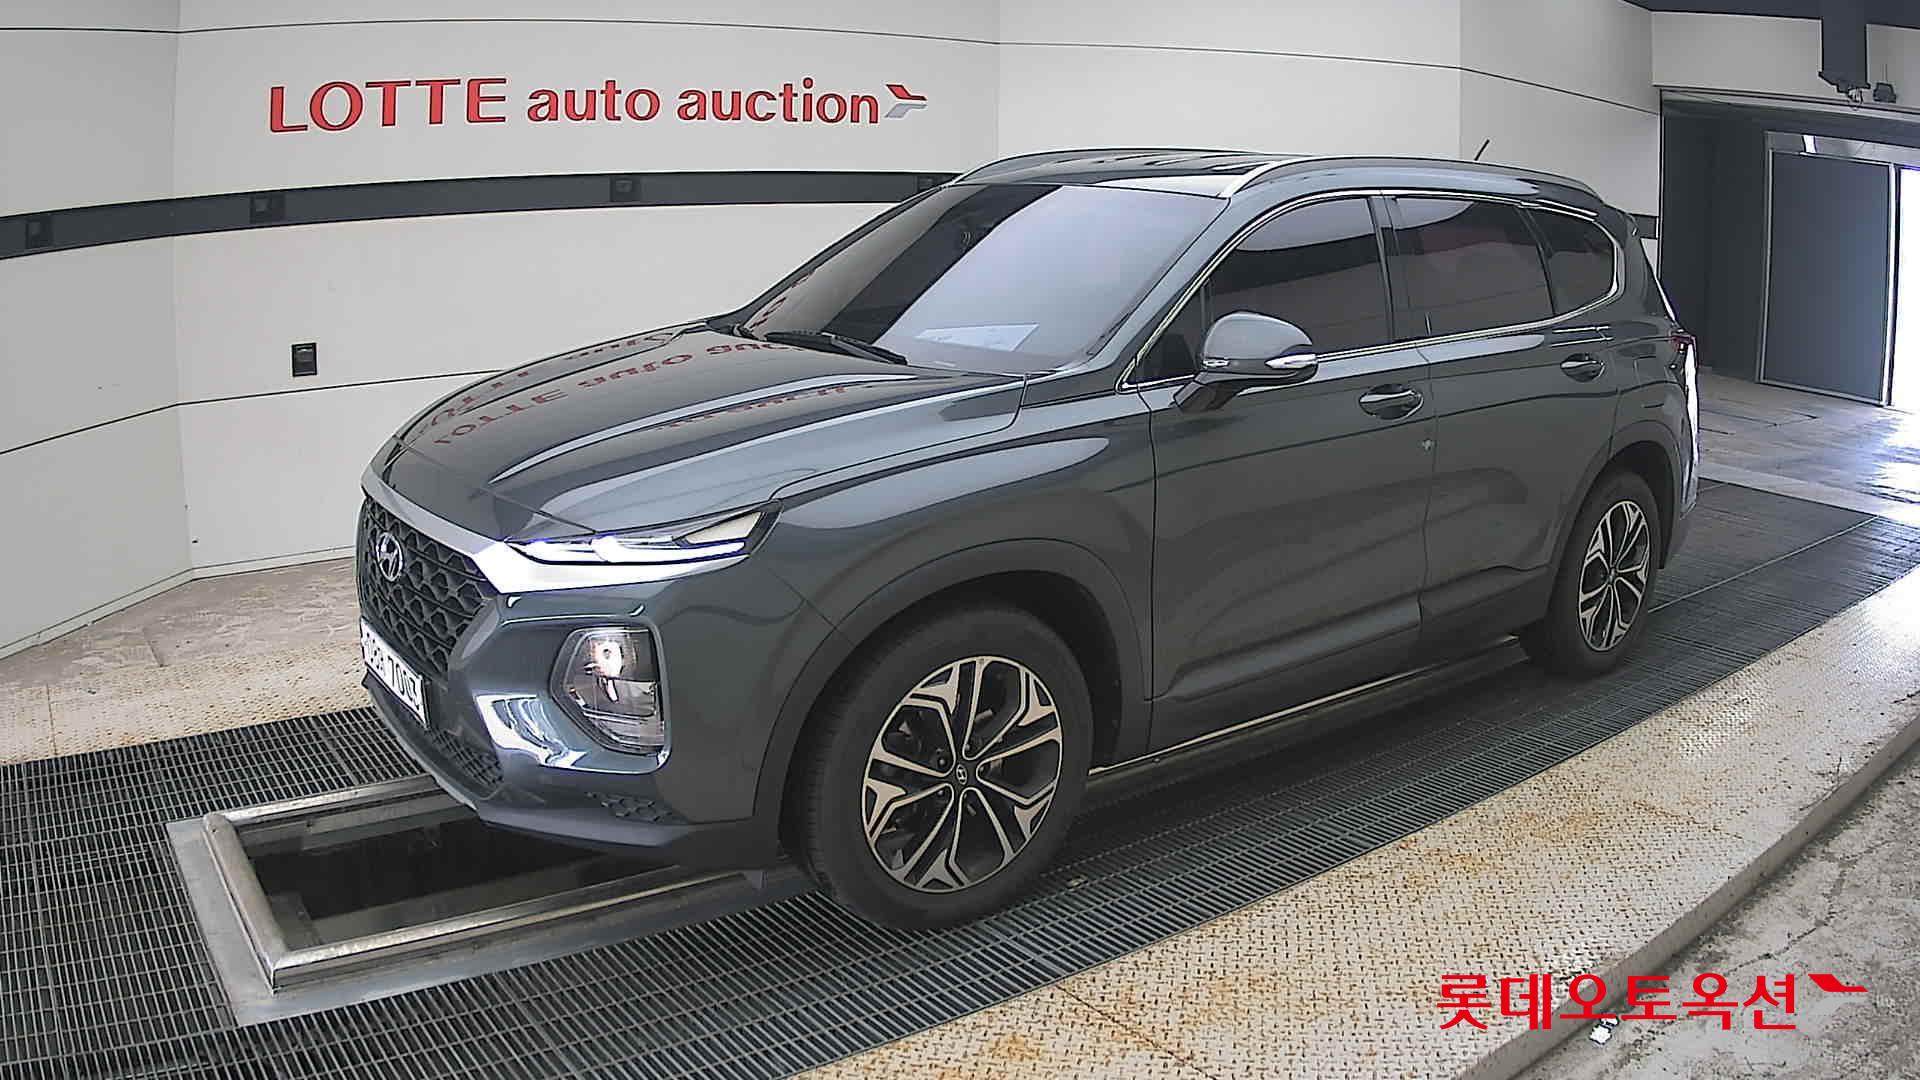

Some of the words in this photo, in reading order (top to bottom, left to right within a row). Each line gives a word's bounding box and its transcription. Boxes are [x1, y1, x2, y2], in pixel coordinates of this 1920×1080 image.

[269, 77, 507, 133] LOTTE
[526, 79, 662, 123] auto
[676, 78, 880, 124] auction
